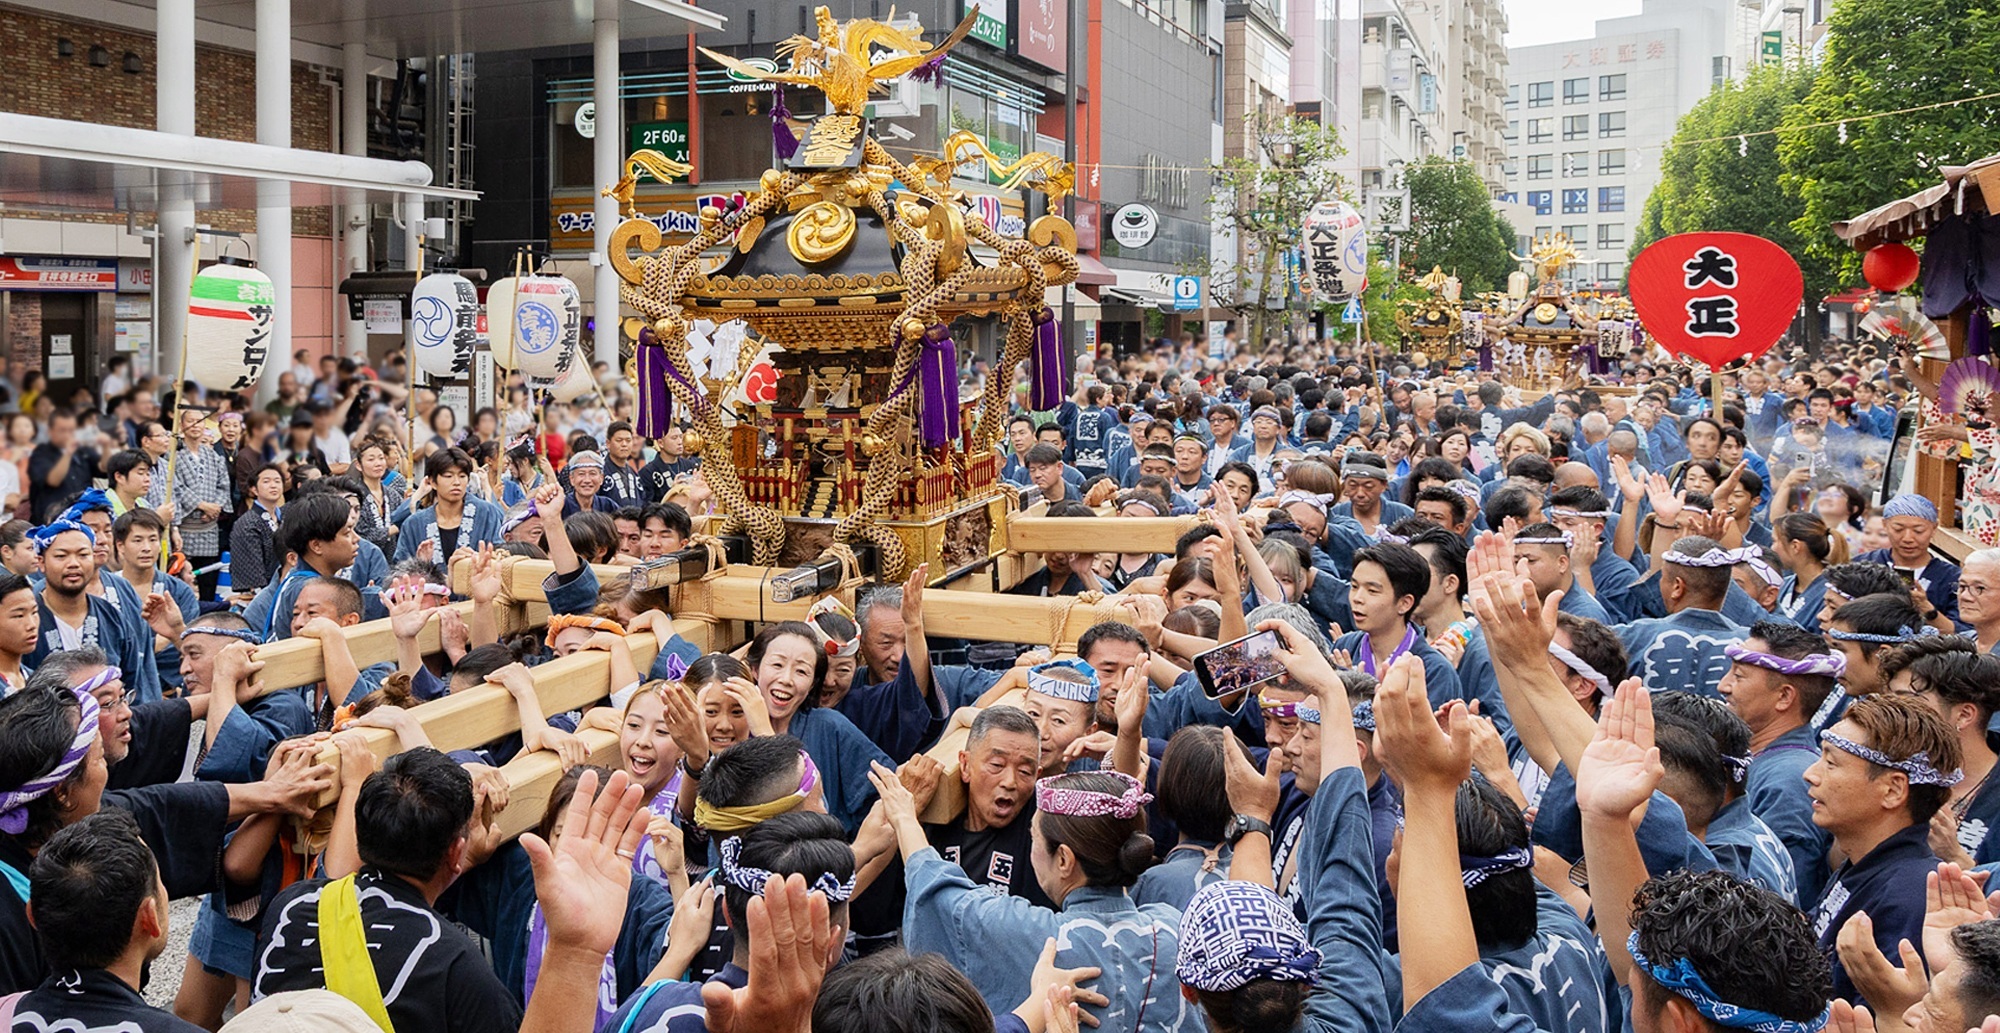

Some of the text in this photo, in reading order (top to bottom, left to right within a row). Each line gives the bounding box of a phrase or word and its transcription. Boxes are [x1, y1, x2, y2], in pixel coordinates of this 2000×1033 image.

[1562, 39, 1666, 70] 大和証券
[643, 130, 661, 145] 2F
[1119, 230, 1149, 240] 珈琲館
[1685, 248, 1738, 337] 大正
